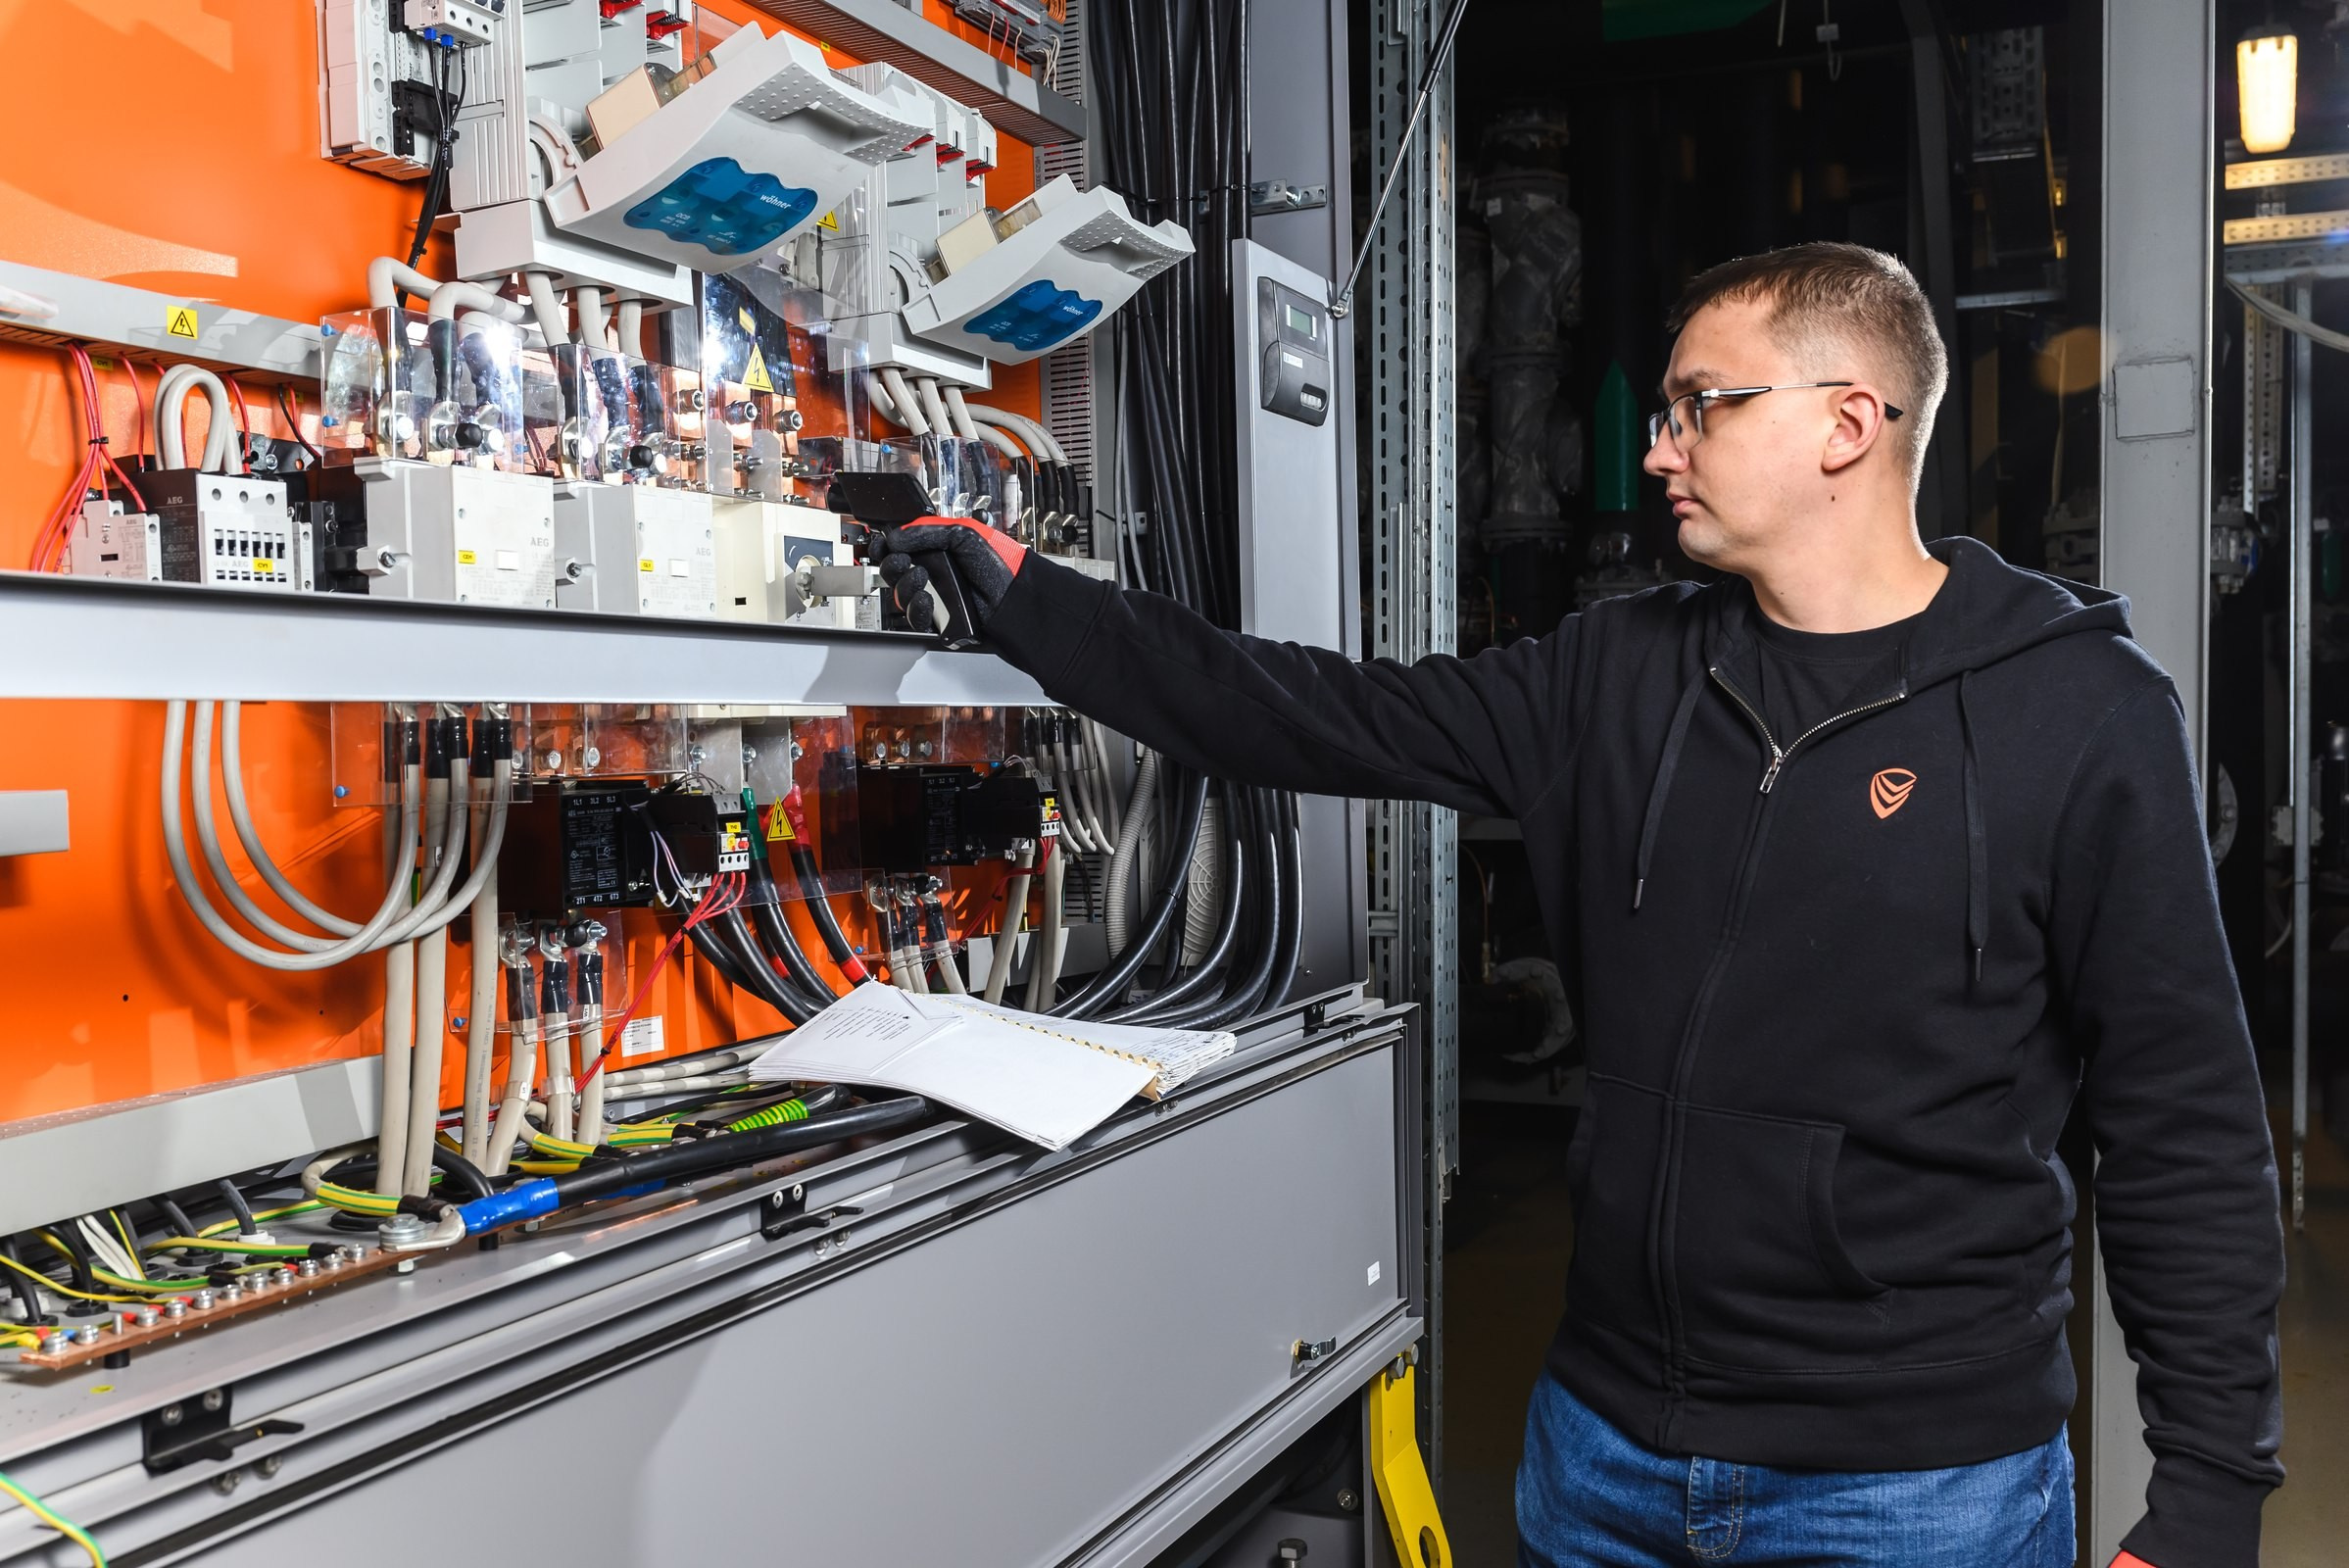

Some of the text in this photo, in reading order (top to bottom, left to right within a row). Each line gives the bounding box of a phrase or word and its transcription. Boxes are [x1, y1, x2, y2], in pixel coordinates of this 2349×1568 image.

[759, 194, 792, 210] wöhner
[167, 496, 183, 505] AEG
[530, 536, 549, 547] AEG
[696, 547, 711, 557] AEG
